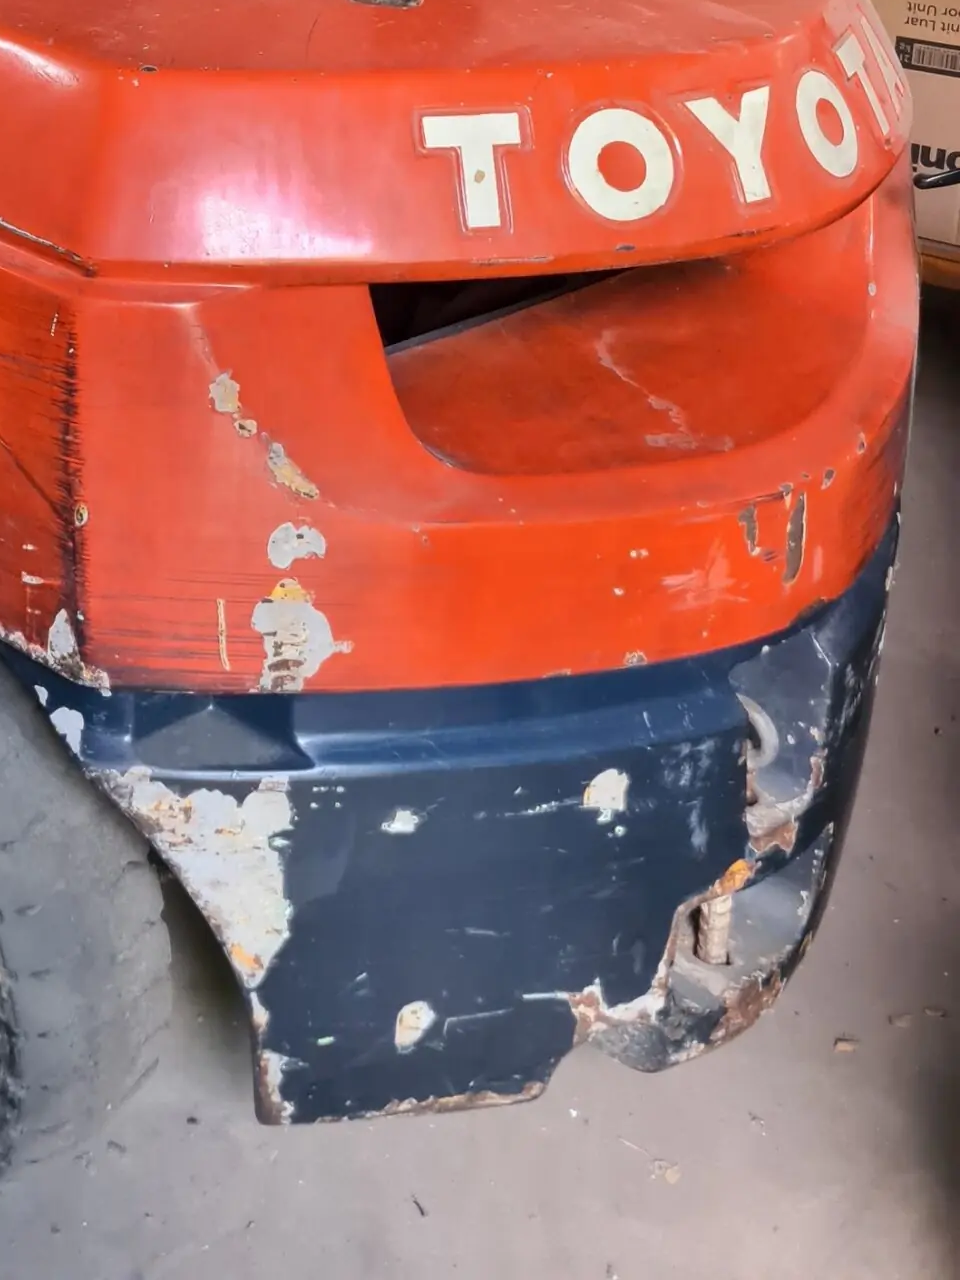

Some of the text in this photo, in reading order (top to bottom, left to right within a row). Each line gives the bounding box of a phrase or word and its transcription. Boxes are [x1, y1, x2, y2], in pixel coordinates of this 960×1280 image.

[907, 1, 937, 16] Unit
[904, 16, 936, 32] Luar
[423, 15, 904, 228] TOYOTA
